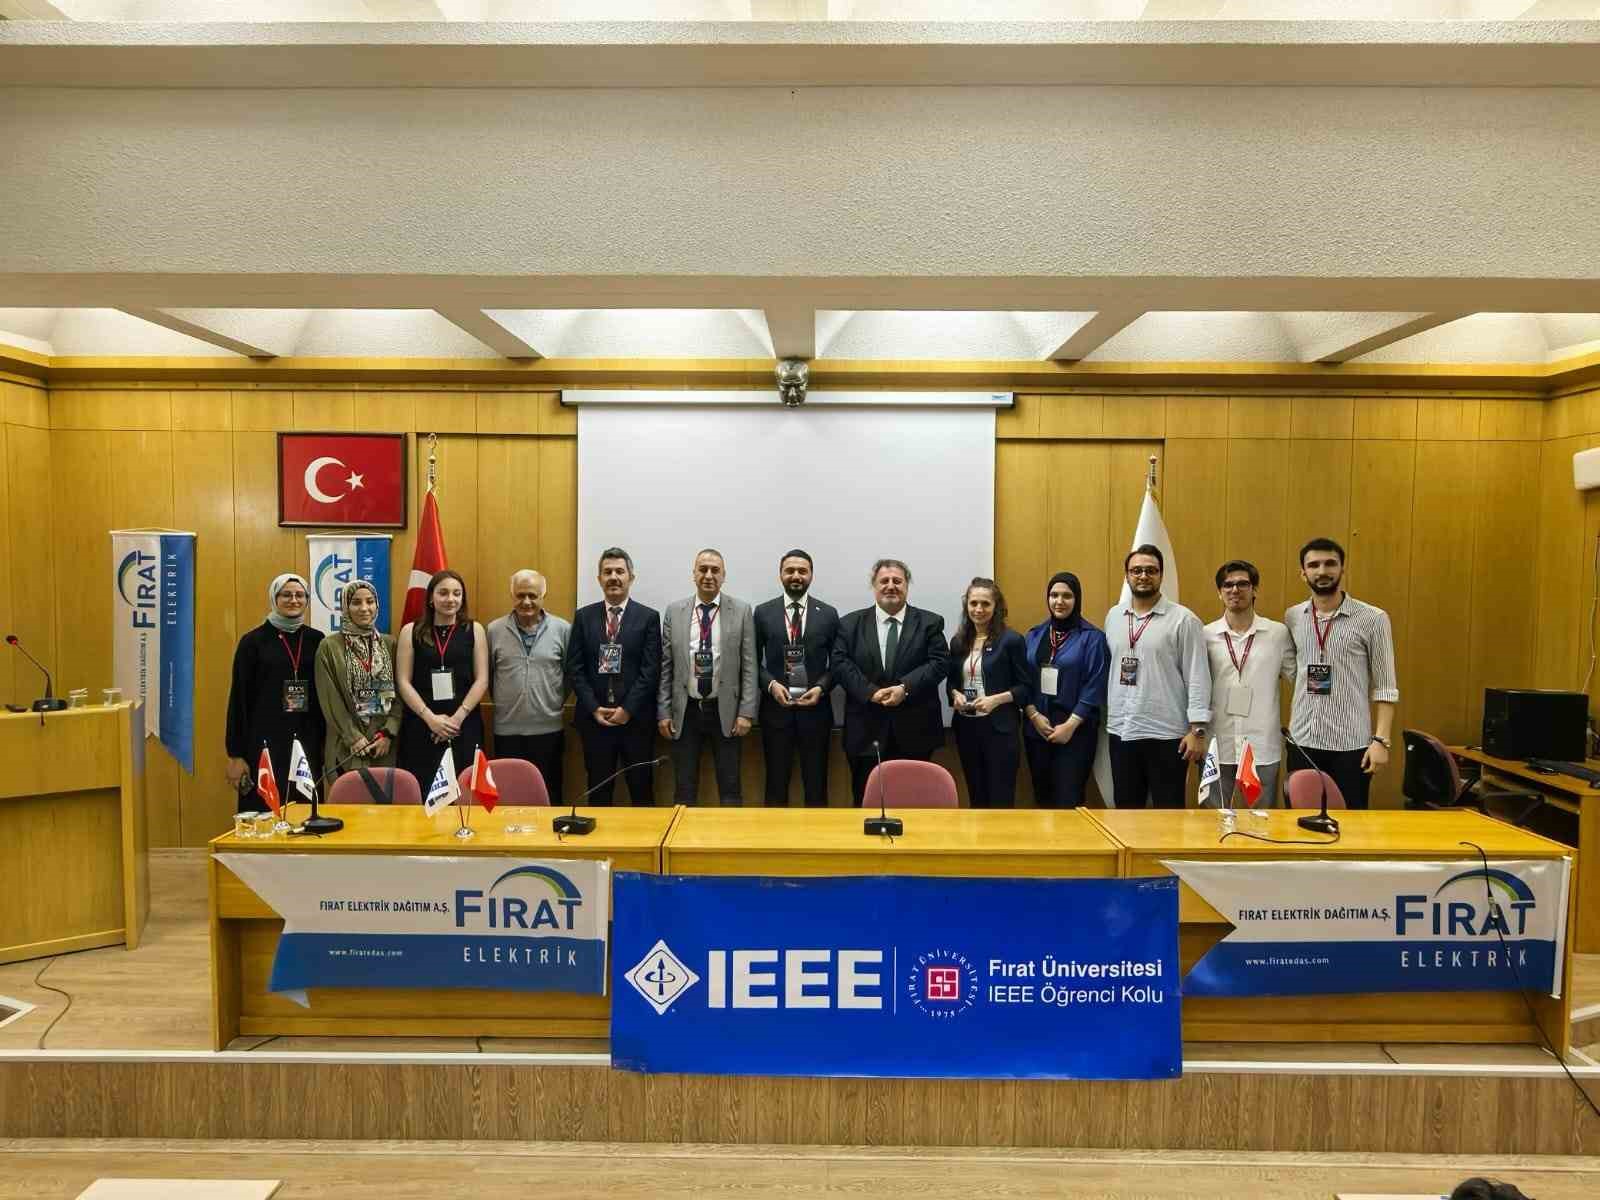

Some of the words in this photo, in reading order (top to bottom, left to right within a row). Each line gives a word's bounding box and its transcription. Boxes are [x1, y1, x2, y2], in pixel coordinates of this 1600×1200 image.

[133, 551, 156, 629] FIRAT
[166, 553, 177, 625] ELEKTRİK
[320, 900, 345, 911] FIRAT
[348, 900, 390, 912] ELEKTRİK
[393, 899, 431, 912] DAĞITIM
[434, 902, 450, 914] A.Ş.
[456, 890, 583, 929] FIRAT
[1239, 910, 1268, 920] FIRAT
[1271, 907, 1321, 920] ELEKTRİK
[1325, 906, 1369, 920] DAĞITIM
[1396, 895, 1536, 935] FIRAT
[463, 946, 576, 965] ELEKTRİK
[989, 959, 1036, 977] Fırat
[1042, 955, 1163, 978] Üniversitesi
[708, 950, 883, 1009] IEEE
[989, 985, 1034, 1003] IEEE
[1041, 982, 1115, 1007] Öğrenci
[1121, 985, 1163, 1003] Kolu
